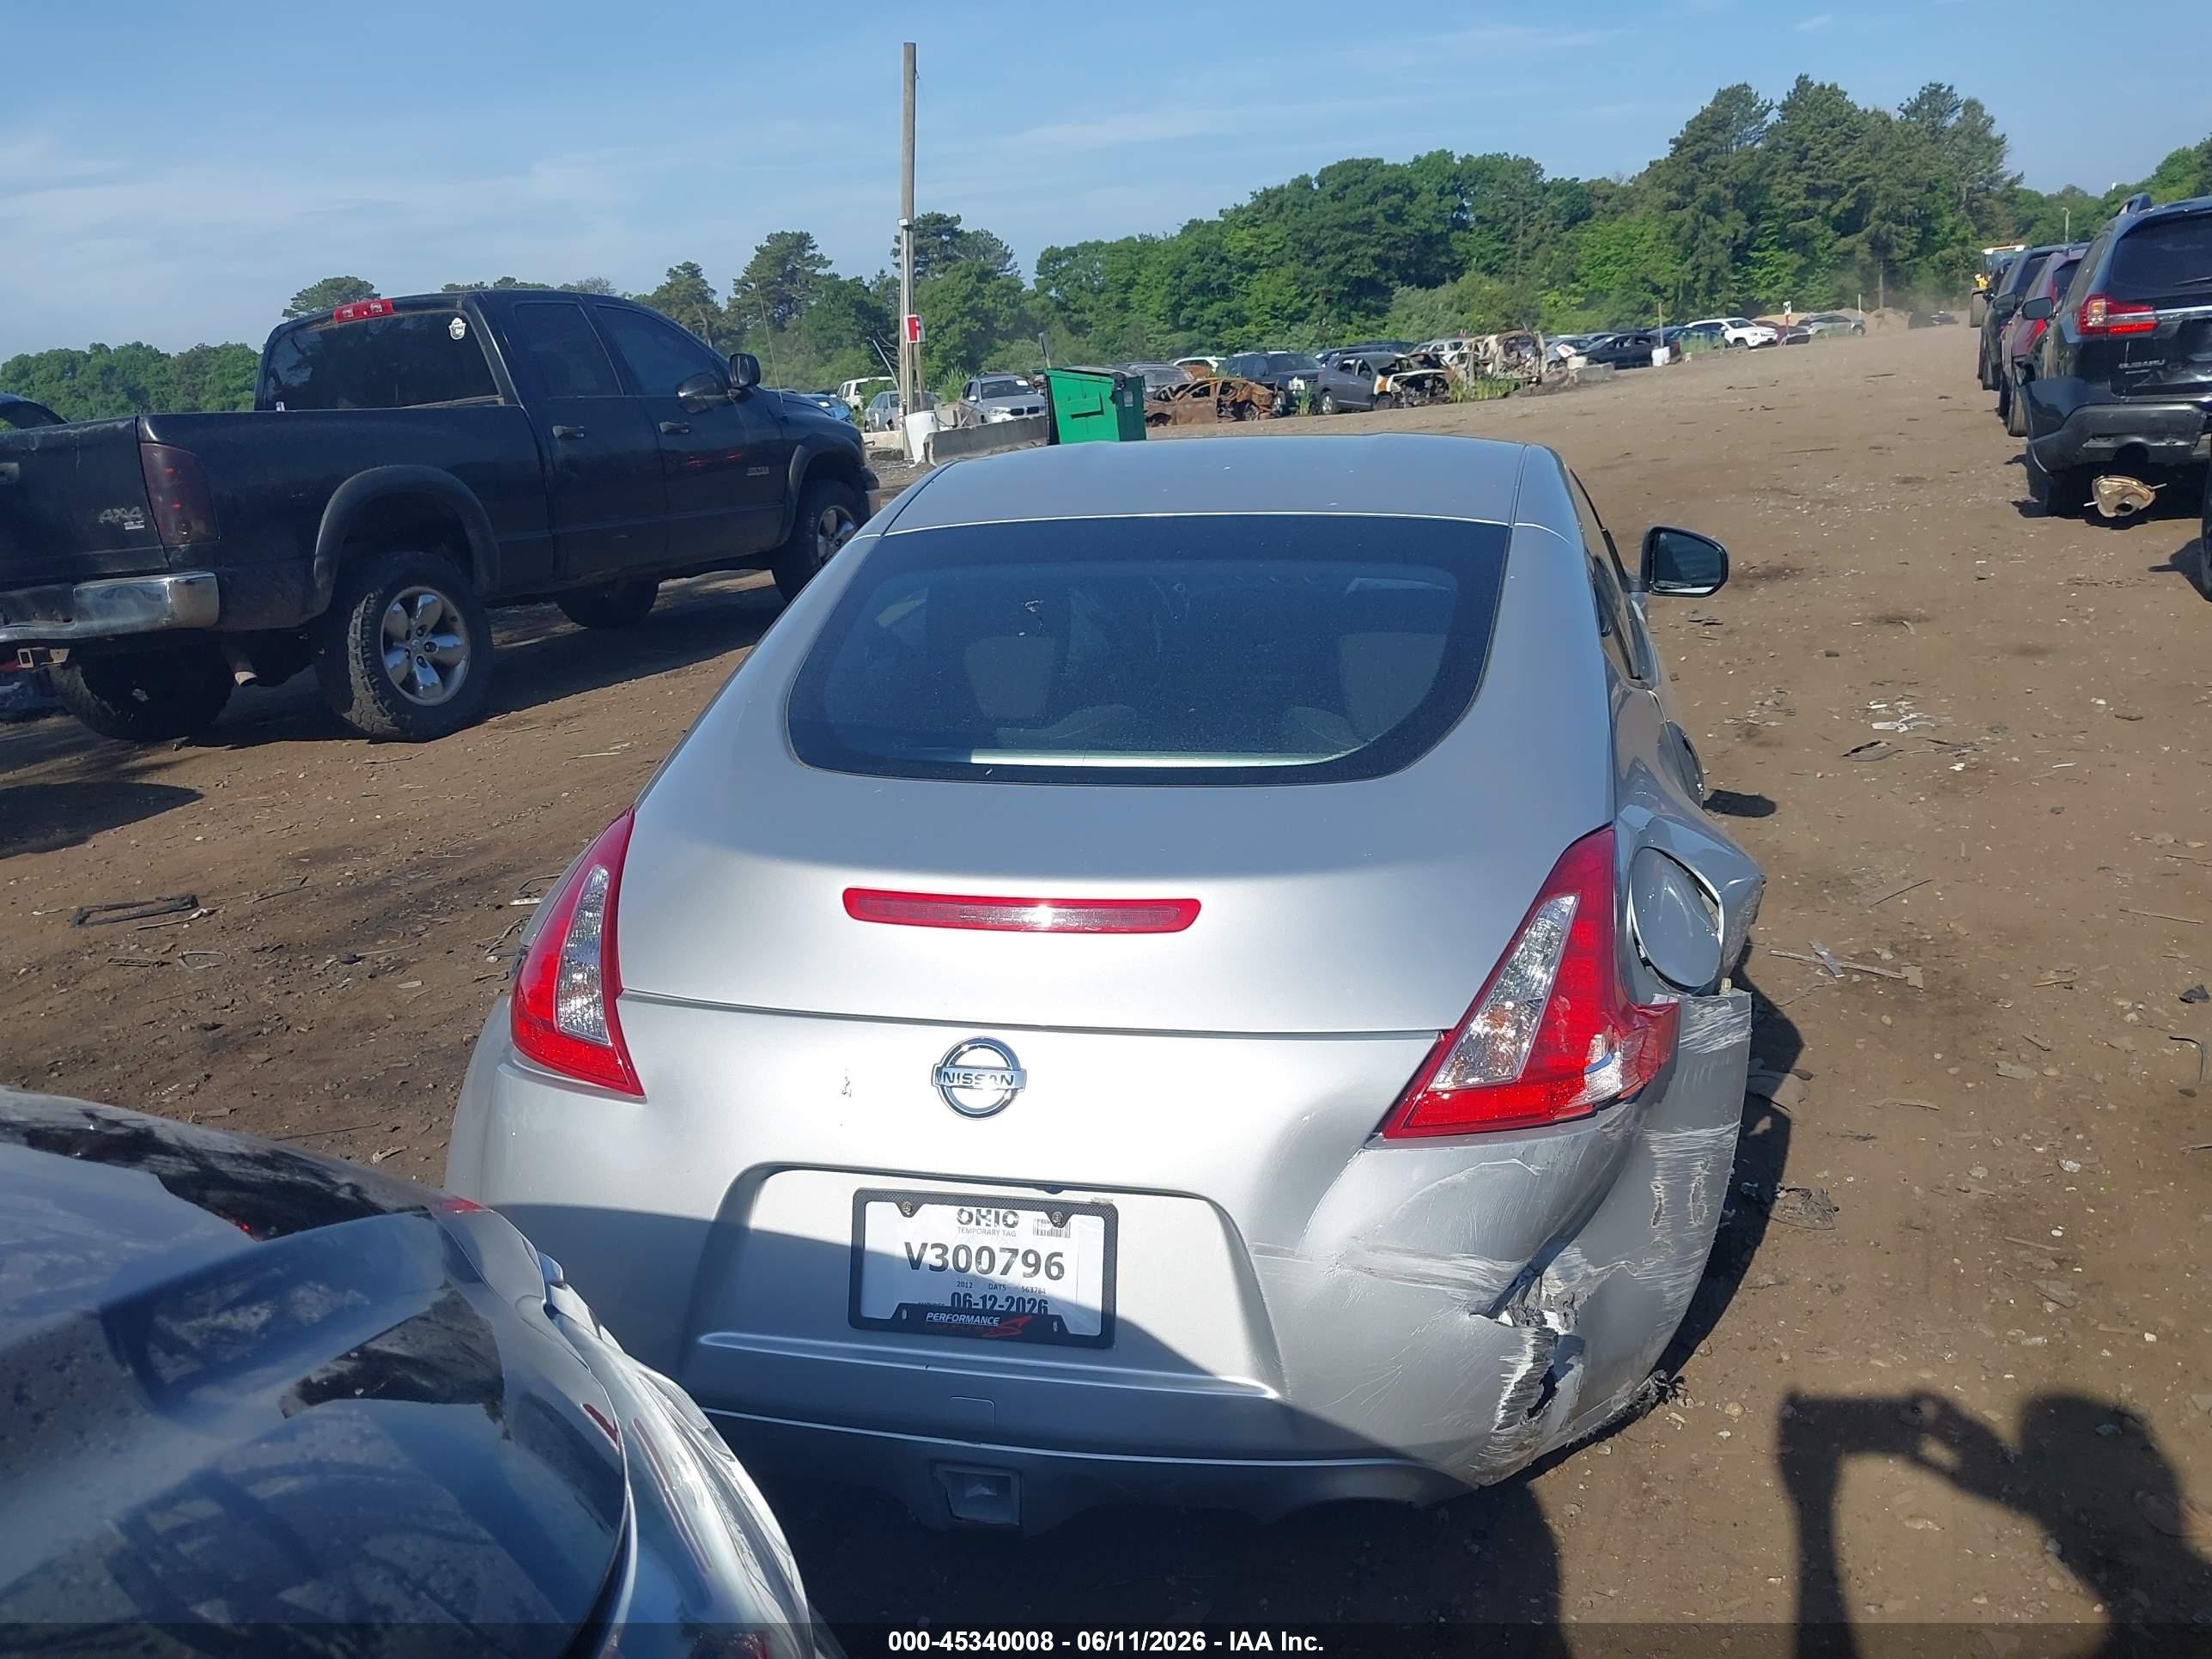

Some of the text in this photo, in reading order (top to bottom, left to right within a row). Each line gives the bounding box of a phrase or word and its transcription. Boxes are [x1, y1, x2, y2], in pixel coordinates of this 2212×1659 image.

[943, 1071, 1014, 1086] NISSAN
[957, 1207, 1019, 1228] OHIO
[957, 1226, 1000, 1237] TEMPORARY
[904, 1242, 1065, 1280] V300796
[951, 1291, 1048, 1315] 06-12-2026
[926, 1311, 1000, 1325] PERFORMANCE
